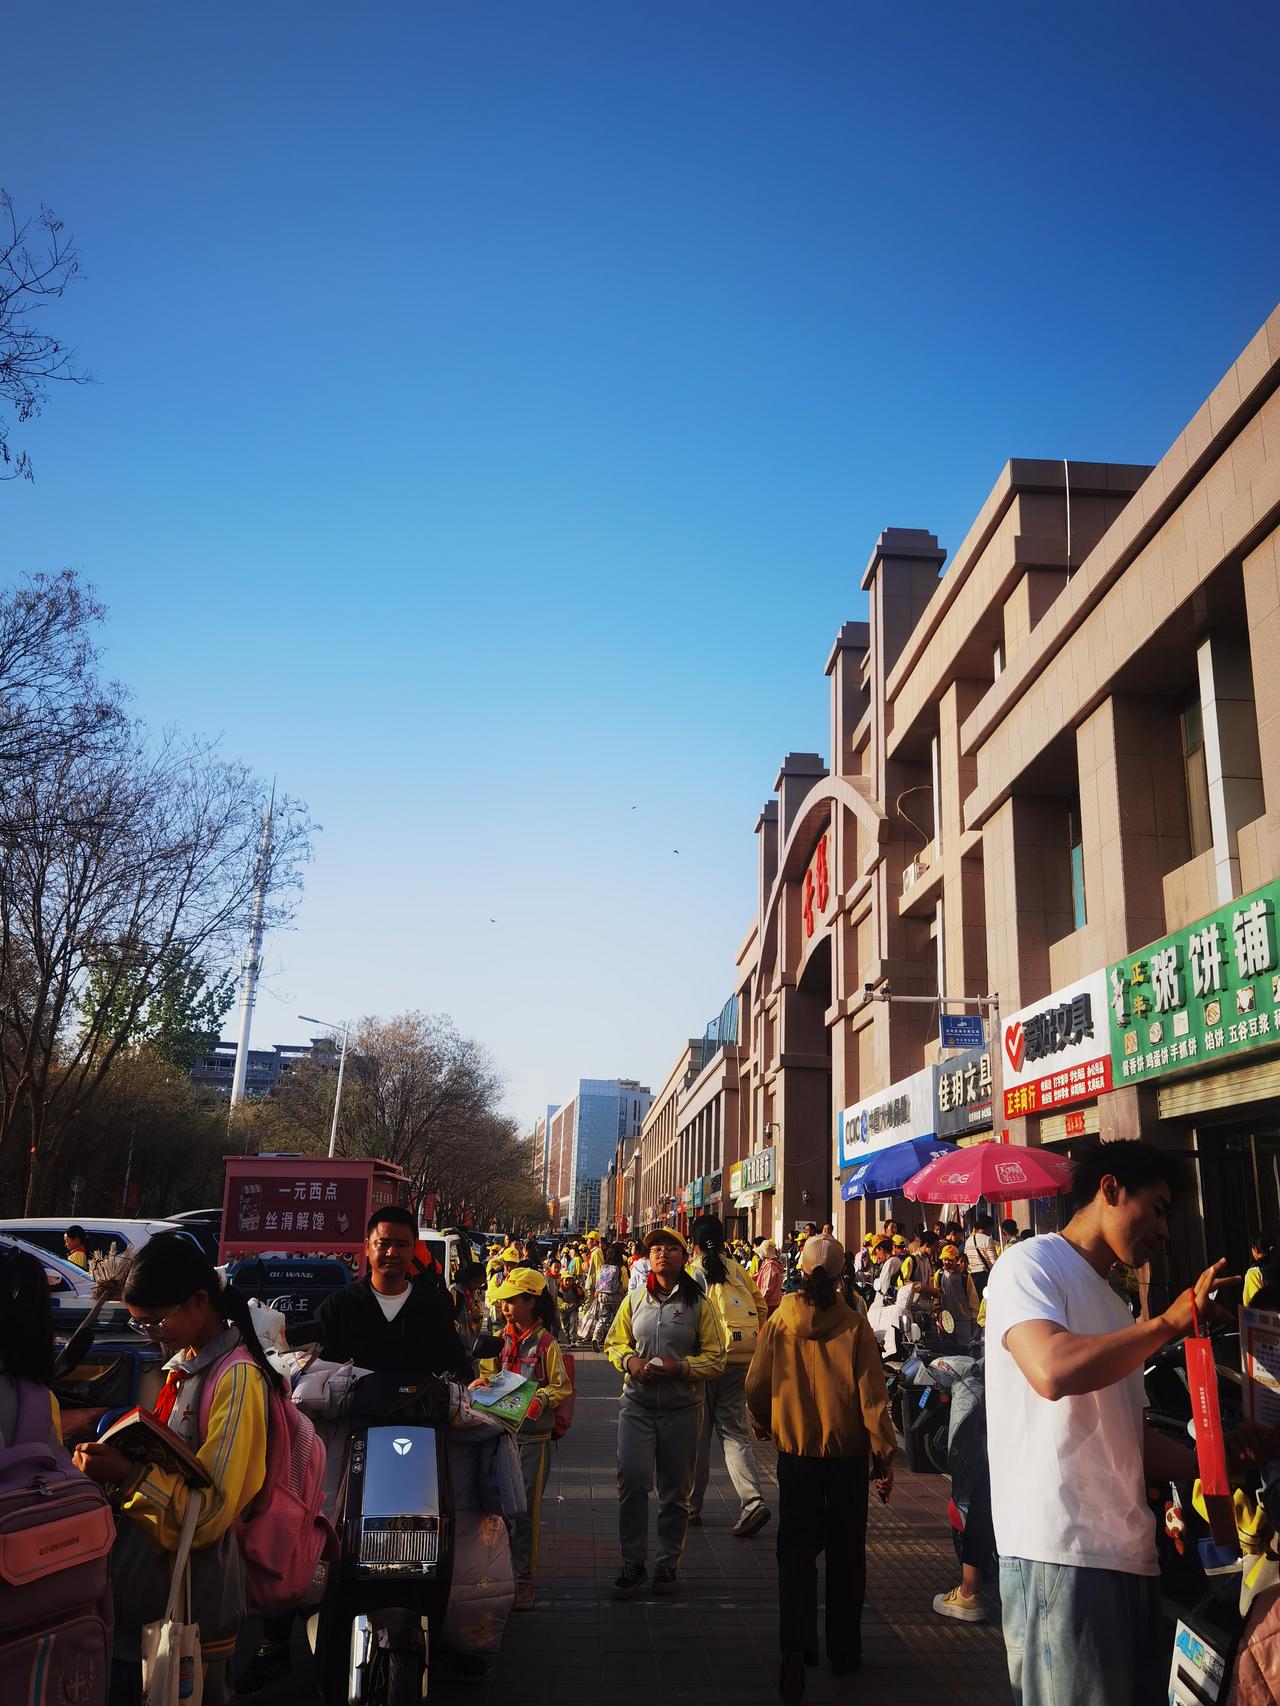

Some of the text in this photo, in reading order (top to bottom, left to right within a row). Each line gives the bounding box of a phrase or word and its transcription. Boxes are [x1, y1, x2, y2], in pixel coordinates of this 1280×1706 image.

[1151, 899, 1275, 1014] 粥饼铺
[1228, 1014, 1270, 1044] 五谷豆浆
[1007, 1085, 1036, 1114] 正丰商行
[279, 1182, 337, 1200] 一元西点
[265, 1212, 325, 1231] 丝滑解馋
[285, 1271, 315, 1279] WANG
